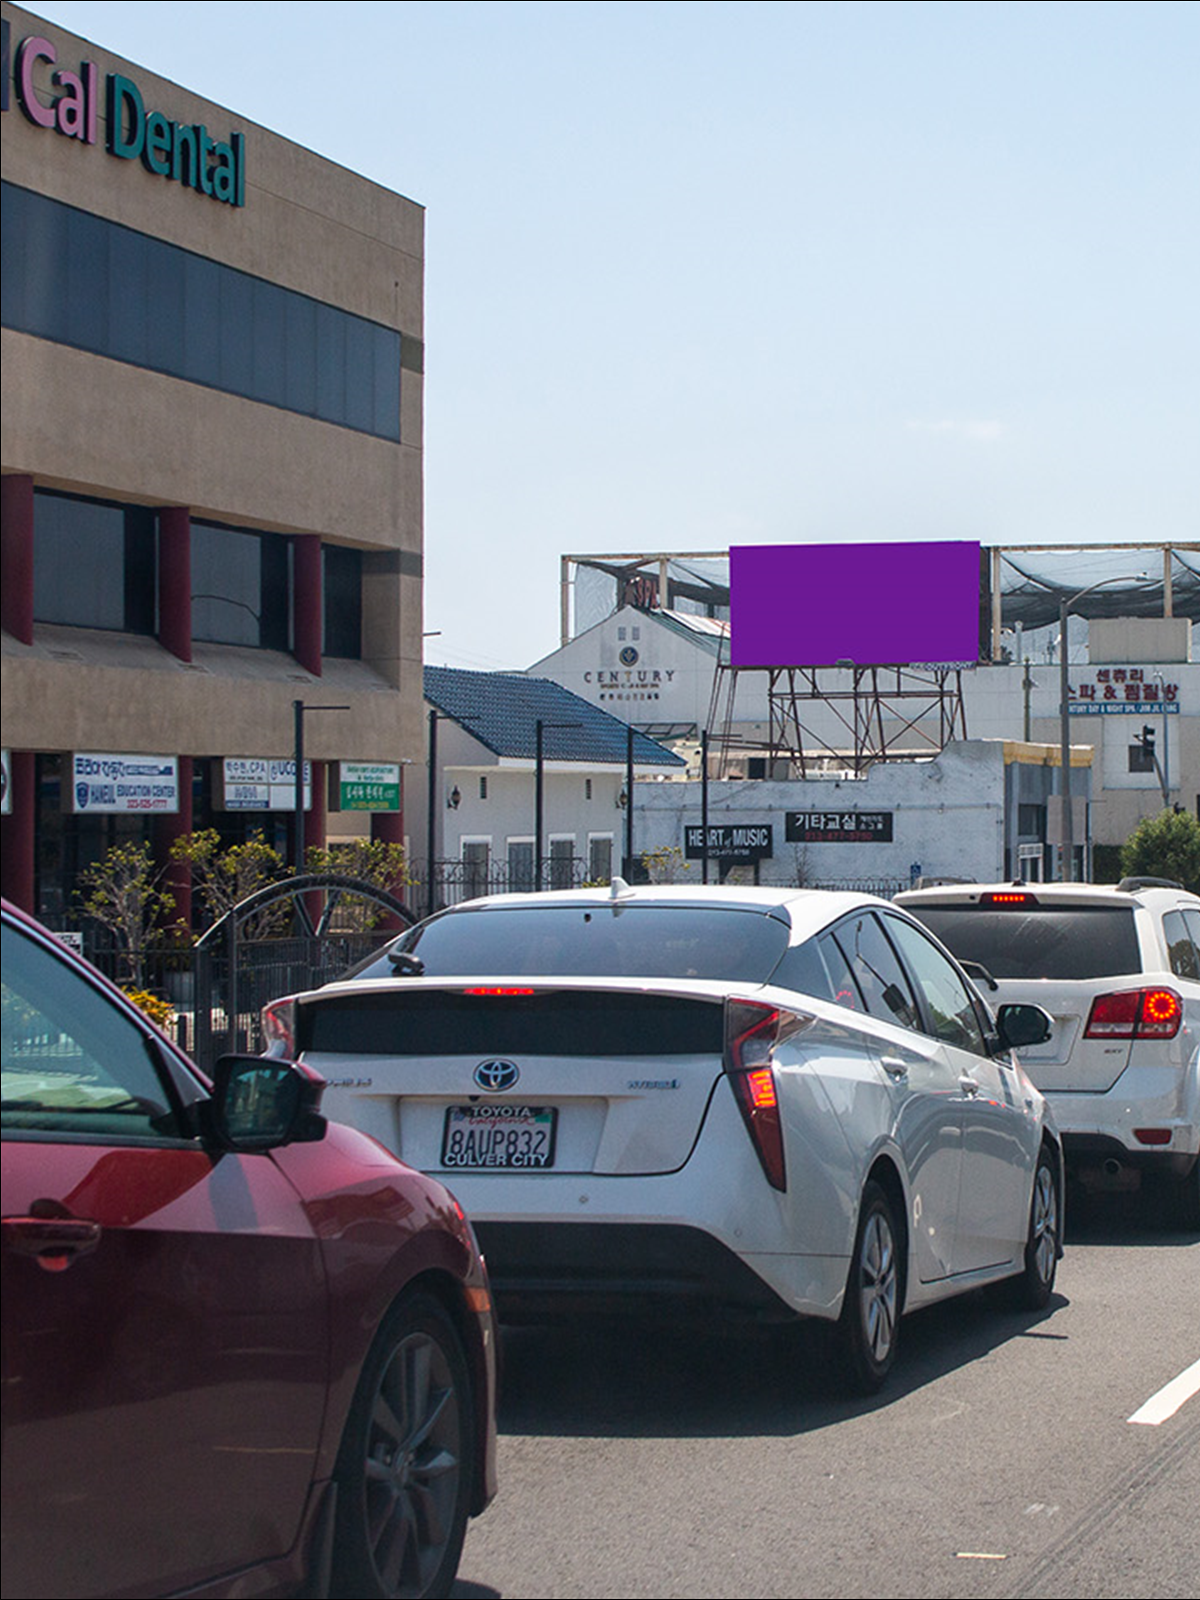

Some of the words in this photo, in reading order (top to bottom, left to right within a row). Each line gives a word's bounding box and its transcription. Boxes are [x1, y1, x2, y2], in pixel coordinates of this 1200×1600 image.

[15, 35, 97, 145] Cal
[106, 73, 245, 207] Dental
[584, 669, 675, 684] CENTURY
[1103, 685, 1117, 700] &
[152, 785, 175, 798] CENTER
[795, 814, 856, 830] 기타교실
[733, 828, 768, 847] MUSIC
[472, 1106, 531, 1117] TOYOTA
[450, 1129, 547, 1156] 8AUP832
[444, 1153, 507, 1166] CULVER
[511, 1153, 549, 1166] CITY
